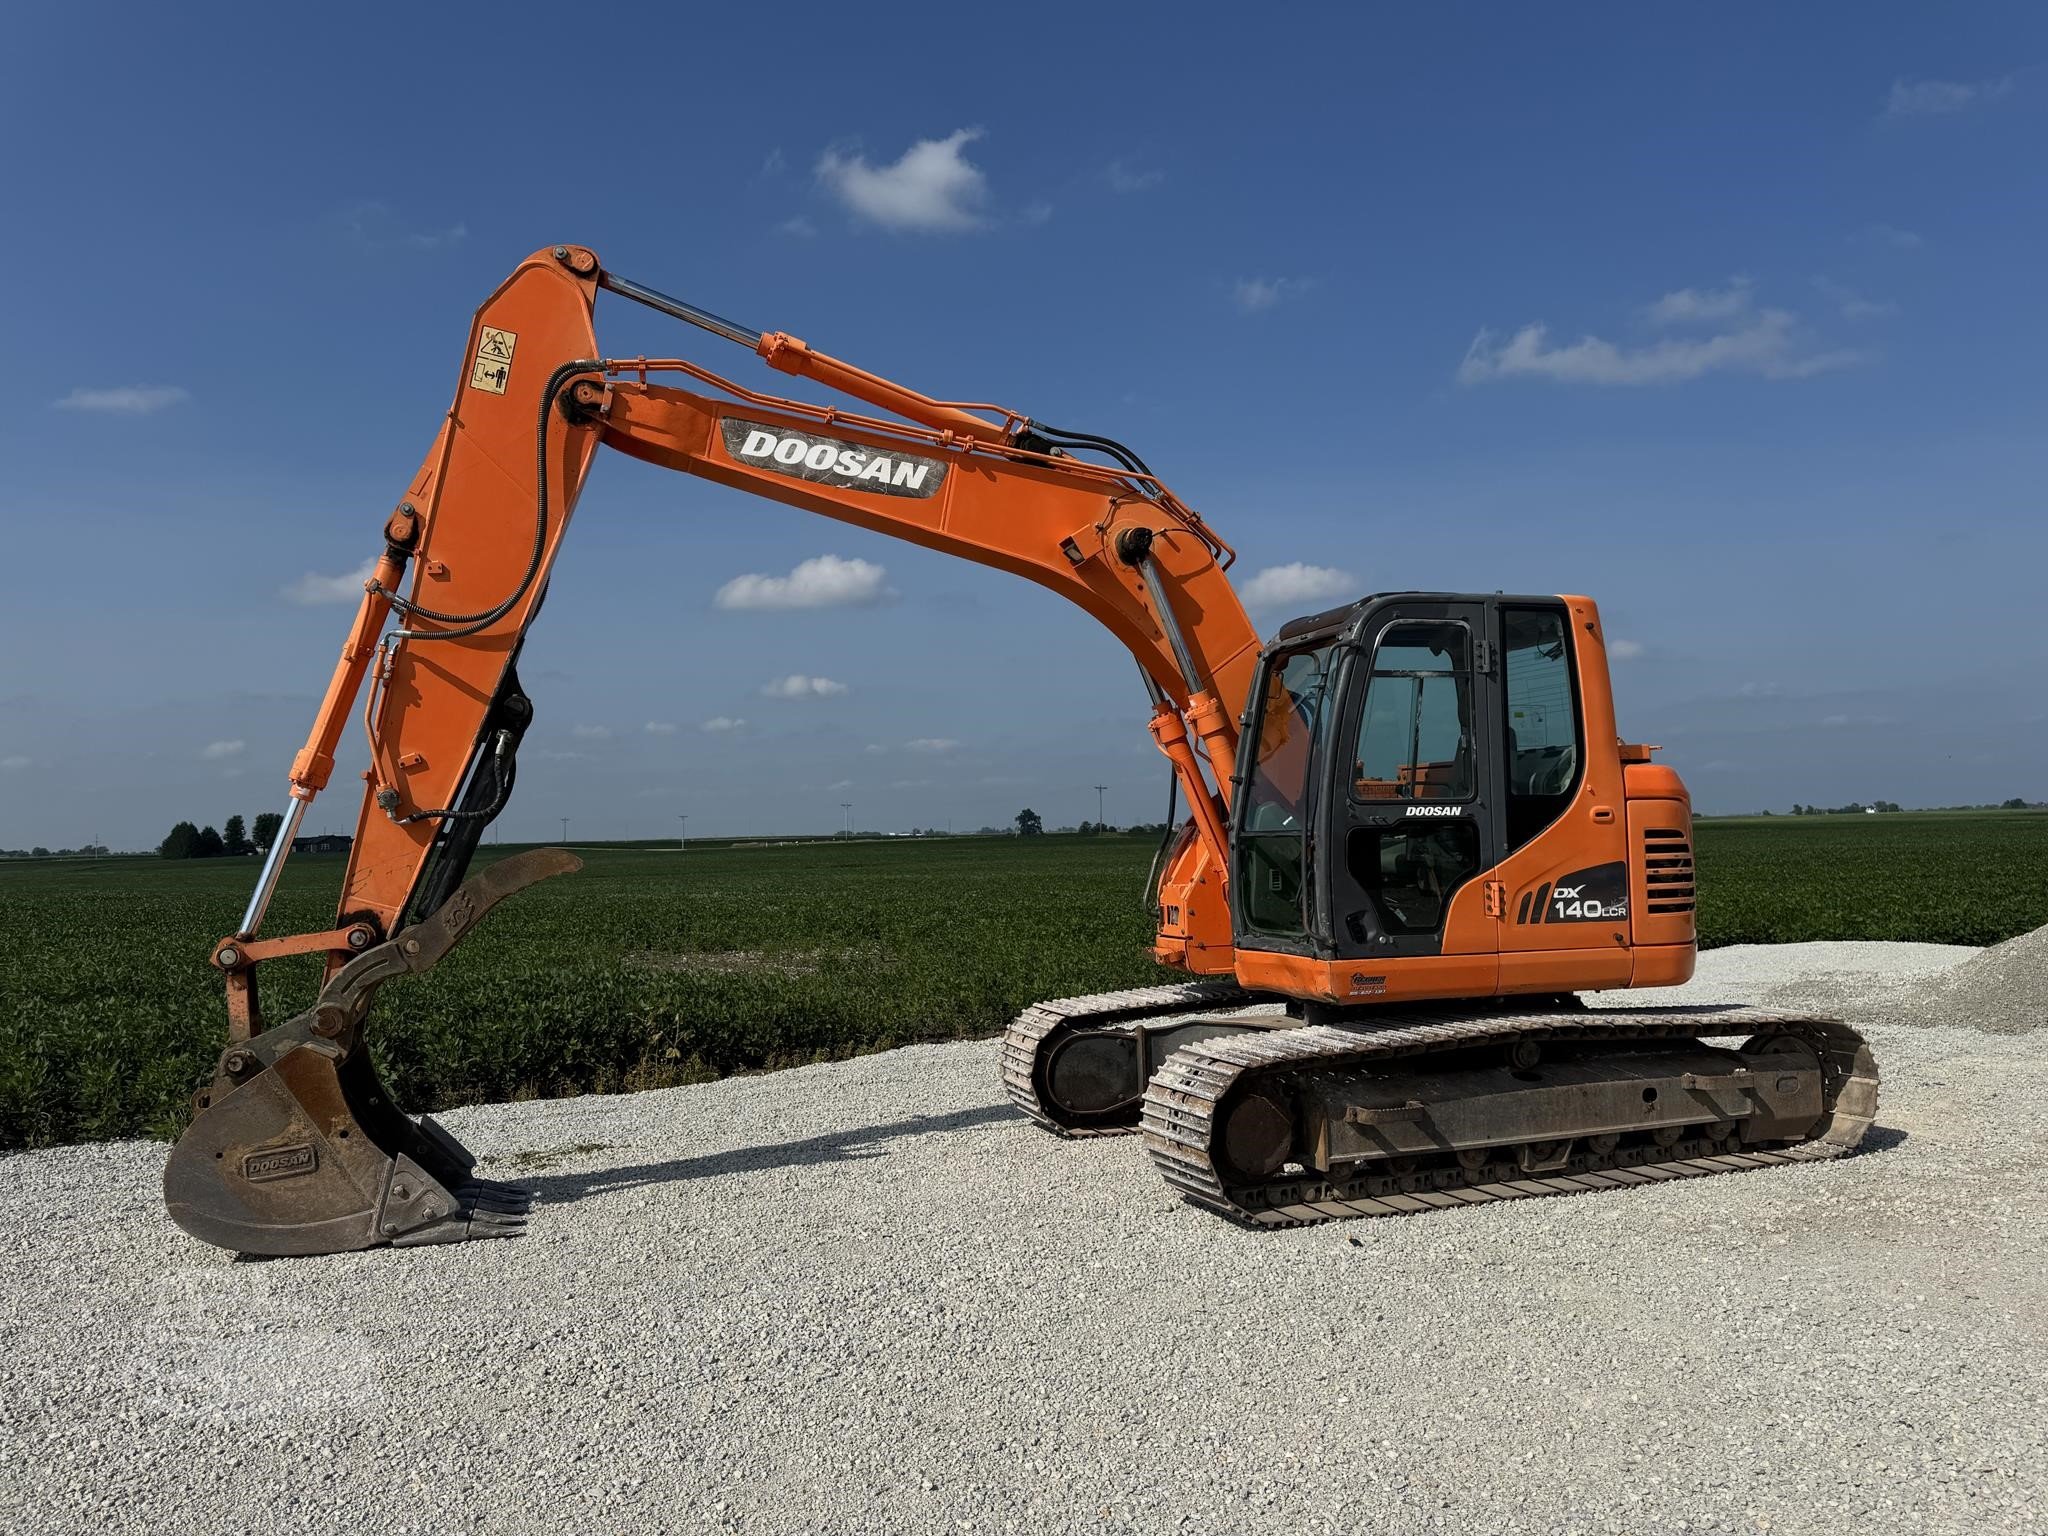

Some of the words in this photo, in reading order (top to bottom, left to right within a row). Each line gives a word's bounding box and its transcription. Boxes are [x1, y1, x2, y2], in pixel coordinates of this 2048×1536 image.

[740, 430, 929, 490] DOOSAN
[1405, 806, 1462, 816] DOOSAN
[1553, 884, 1586, 899] DX
[250, 1153, 310, 1173] DOOSAN
